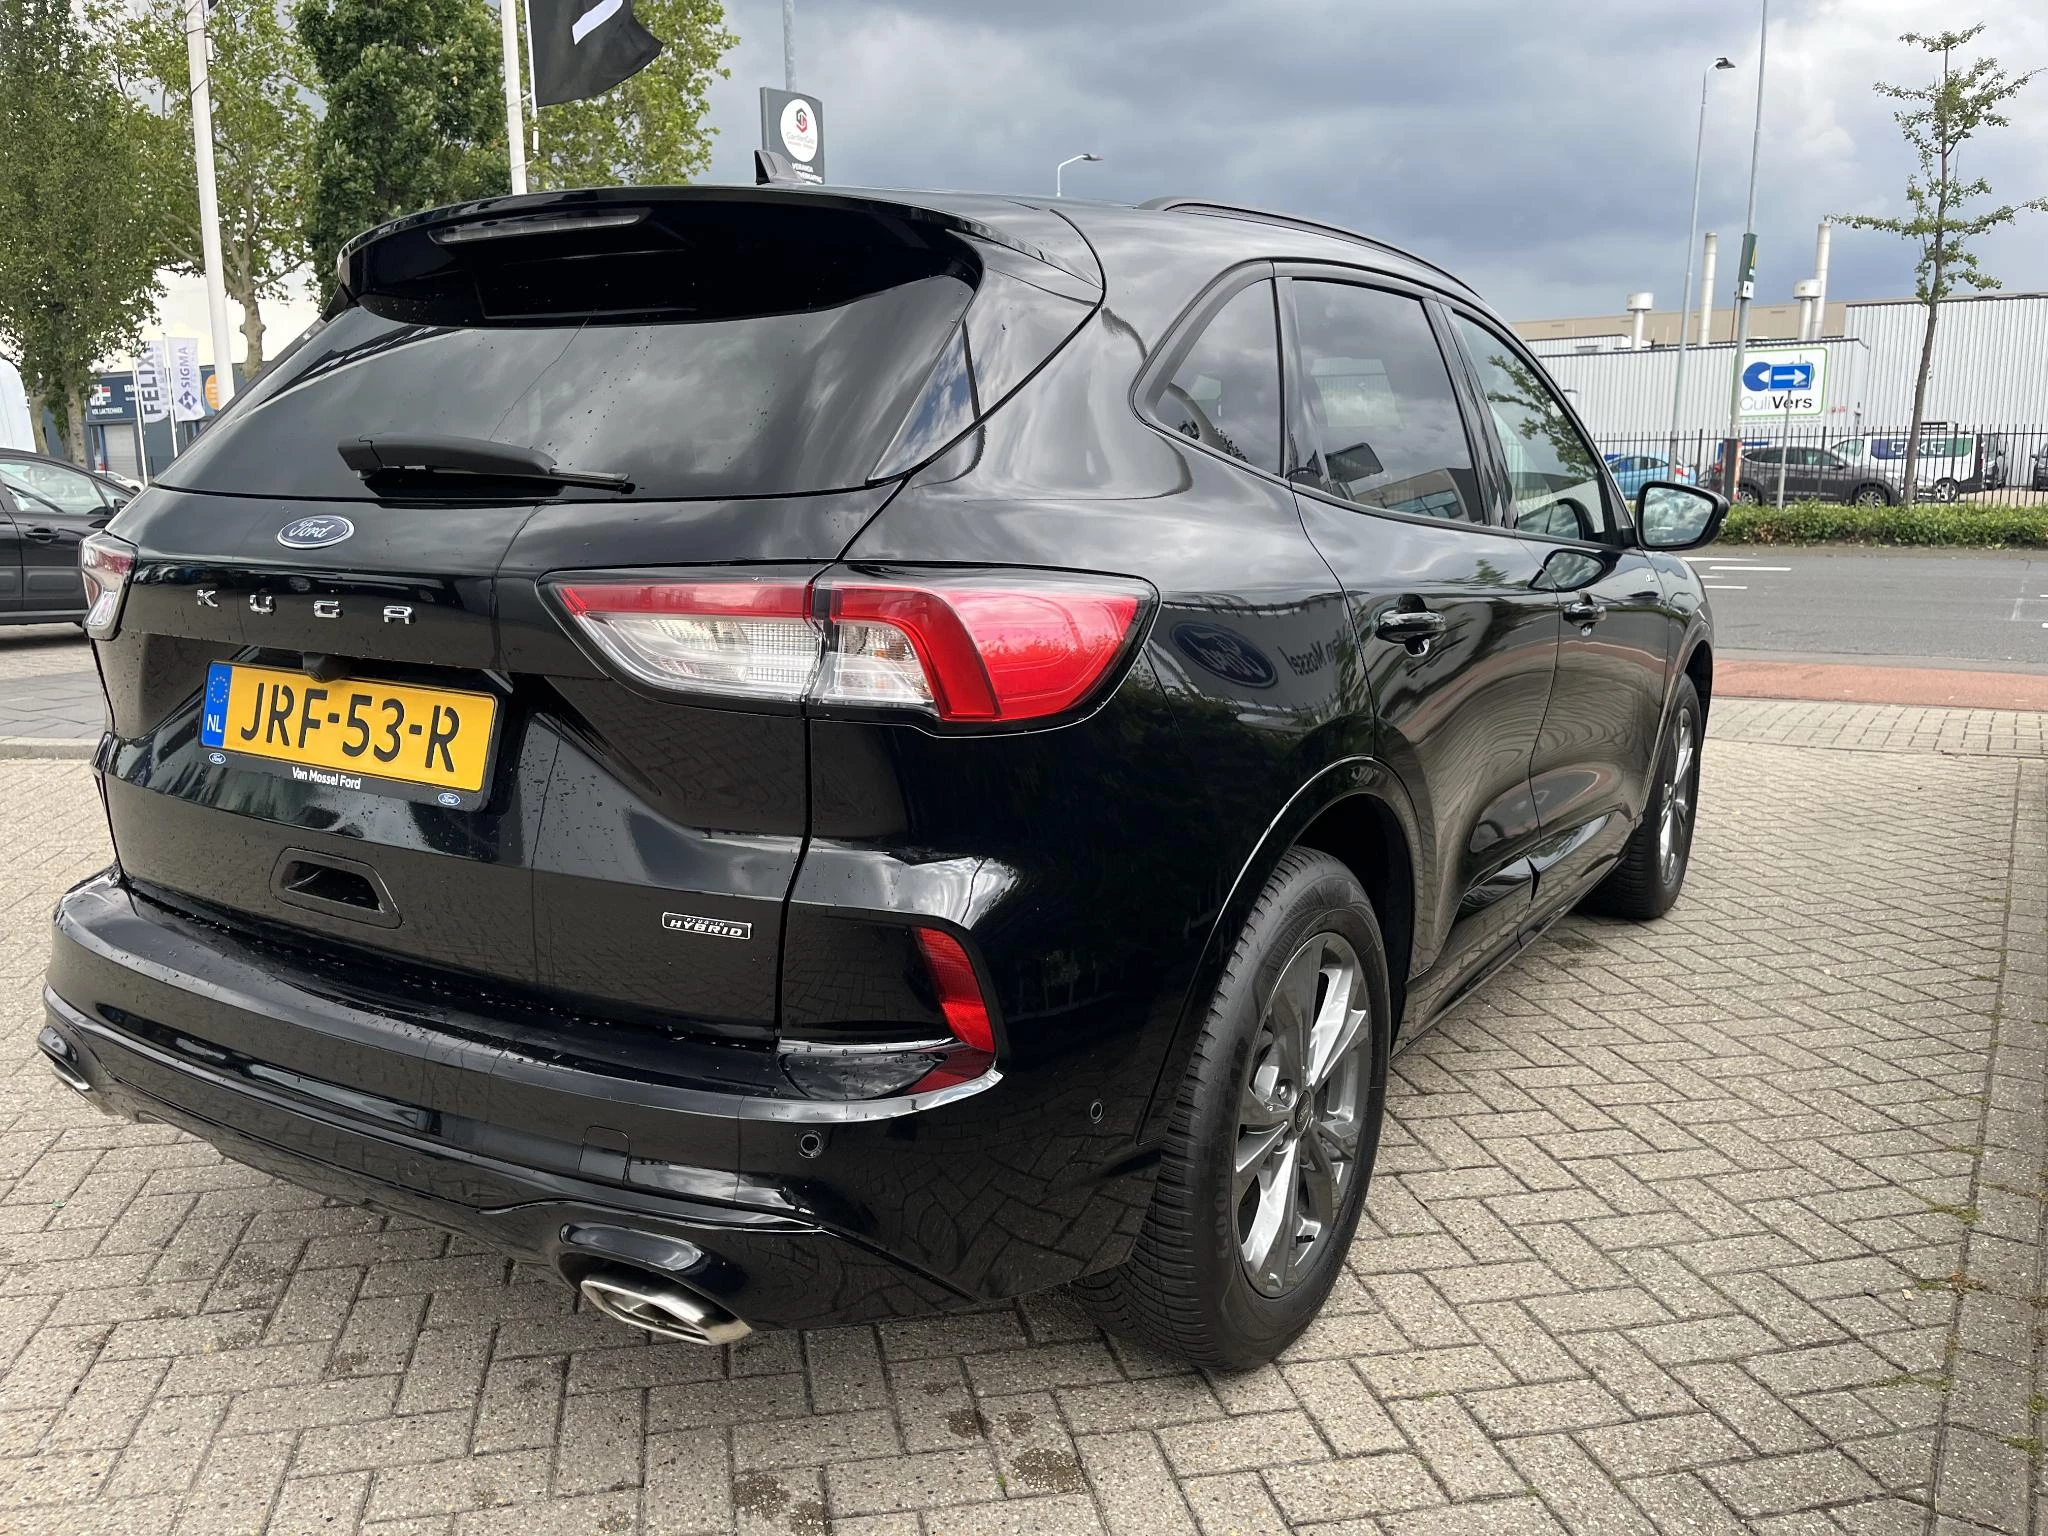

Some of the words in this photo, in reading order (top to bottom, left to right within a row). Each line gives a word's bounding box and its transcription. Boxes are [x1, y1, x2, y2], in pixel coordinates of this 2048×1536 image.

[178, 346, 191, 389] SIGMA
[1739, 395, 1812, 411] CuliVers
[289, 519, 335, 540] Ford
[196, 588, 416, 625] KUGA
[206, 713, 223, 734] NL
[240, 682, 461, 773] JRF-53-R
[292, 767, 308, 781] Van
[308, 771, 338, 786] Mossel
[339, 775, 361, 790] Ford
[669, 919, 743, 937] HYBRID
[686, 917, 725, 927] PLUG-IN
